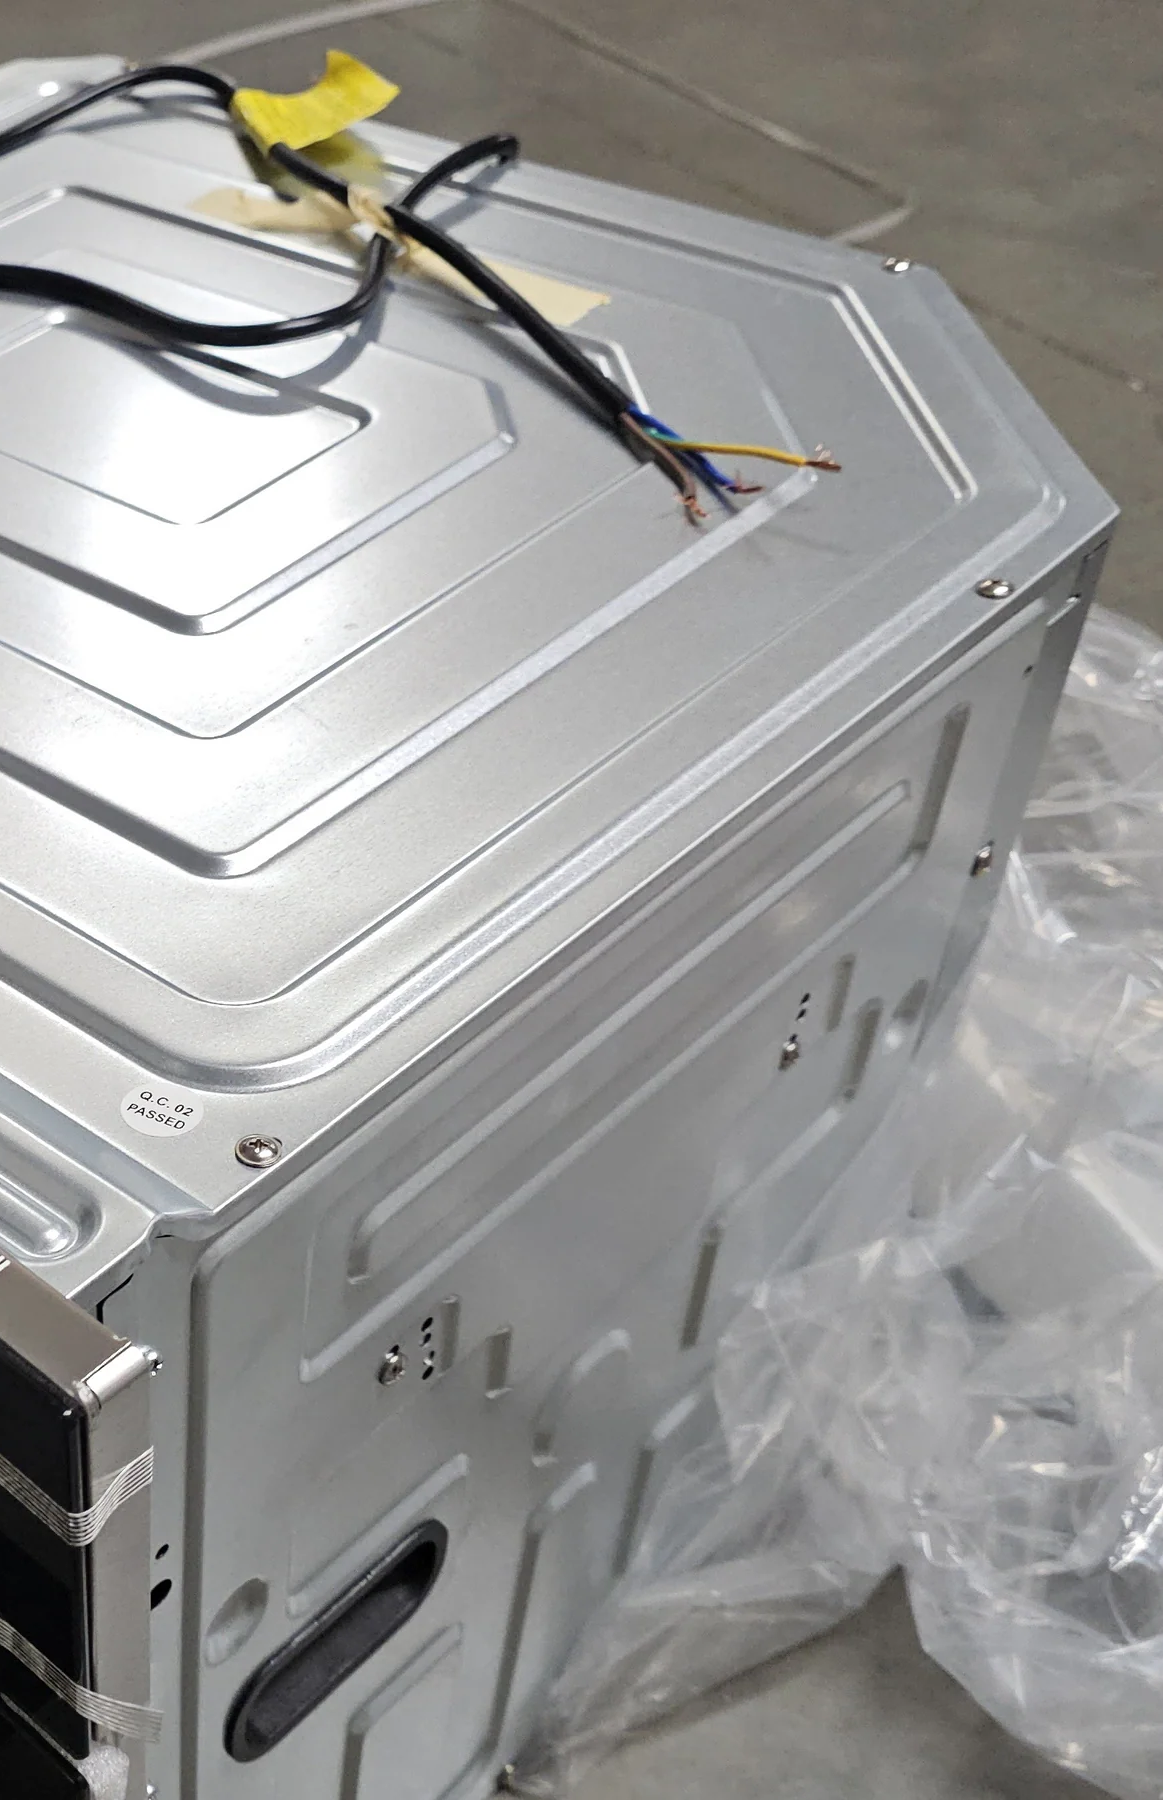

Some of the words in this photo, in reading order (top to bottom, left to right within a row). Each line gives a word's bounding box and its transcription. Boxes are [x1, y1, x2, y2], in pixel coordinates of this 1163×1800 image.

[127, 1103, 186, 1130] PASSED
[140, 1091, 170, 1109] Q.C.
[174, 1104, 194, 1117] 02
